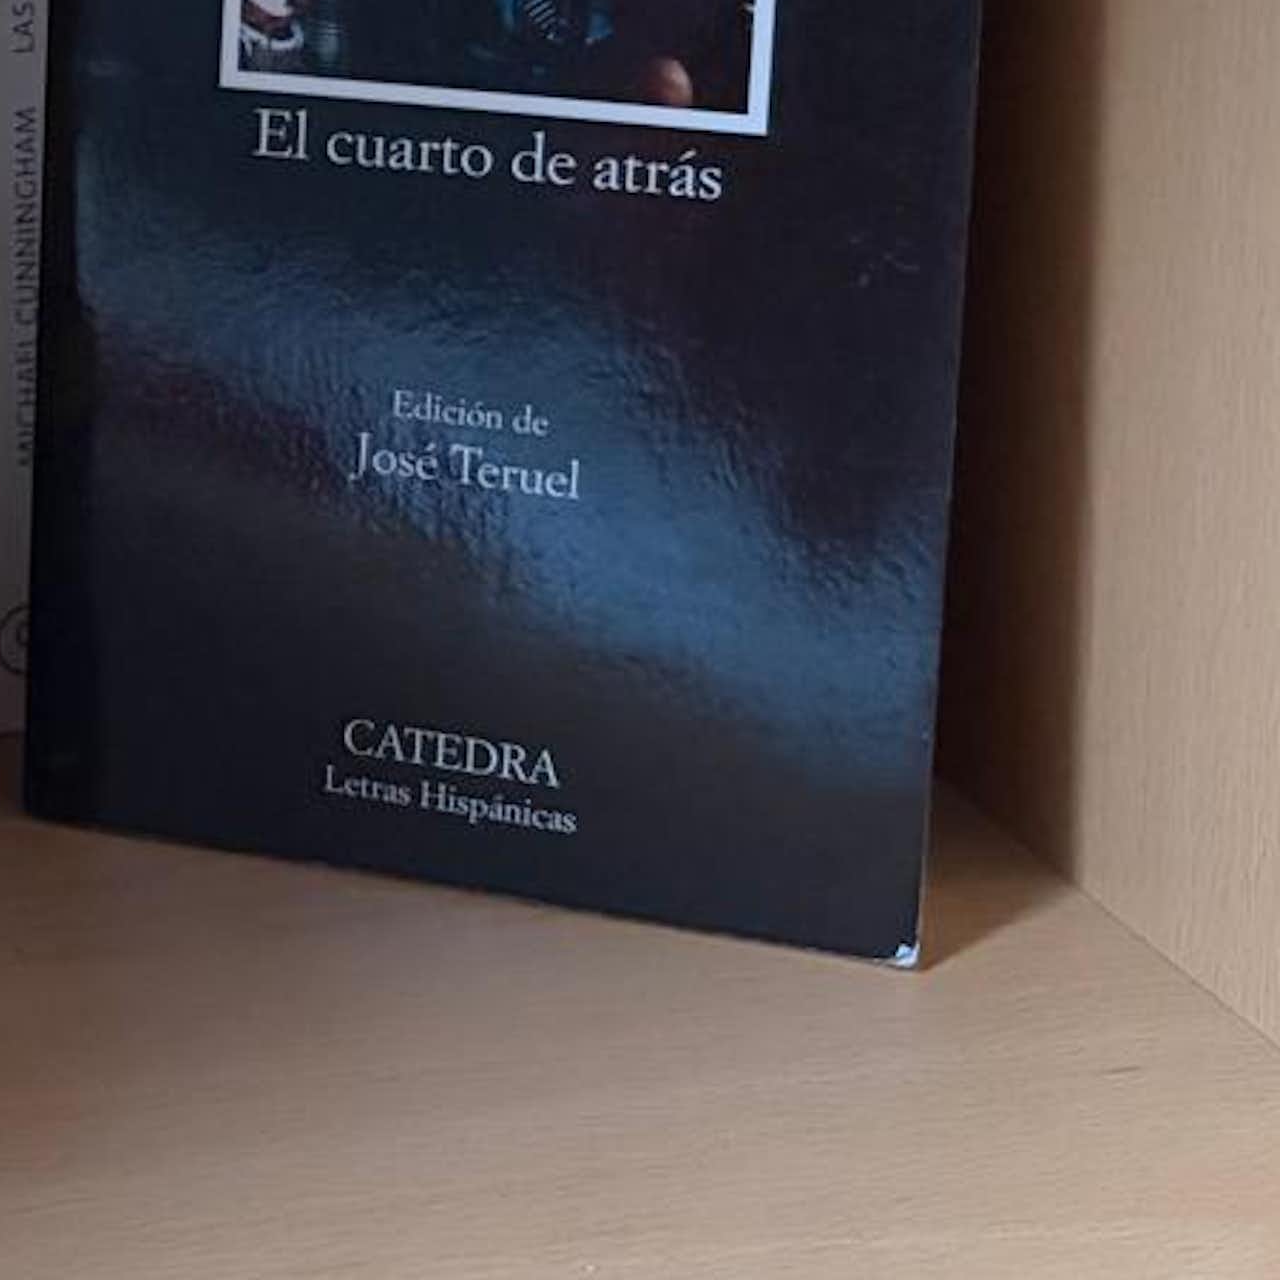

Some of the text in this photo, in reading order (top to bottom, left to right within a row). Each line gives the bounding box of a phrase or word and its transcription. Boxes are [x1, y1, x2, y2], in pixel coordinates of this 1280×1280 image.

[10, 2, 35, 54] LAS
[253, 107, 724, 202] El cuarto de atrás
[14, 107, 38, 326] CUNNINGHAM
[392, 389, 549, 437] Edición de
[347, 432, 580, 500] José Teruel
[344, 718, 560, 790] CATEDRA
[324, 764, 578, 833] Letras Hispánicas
